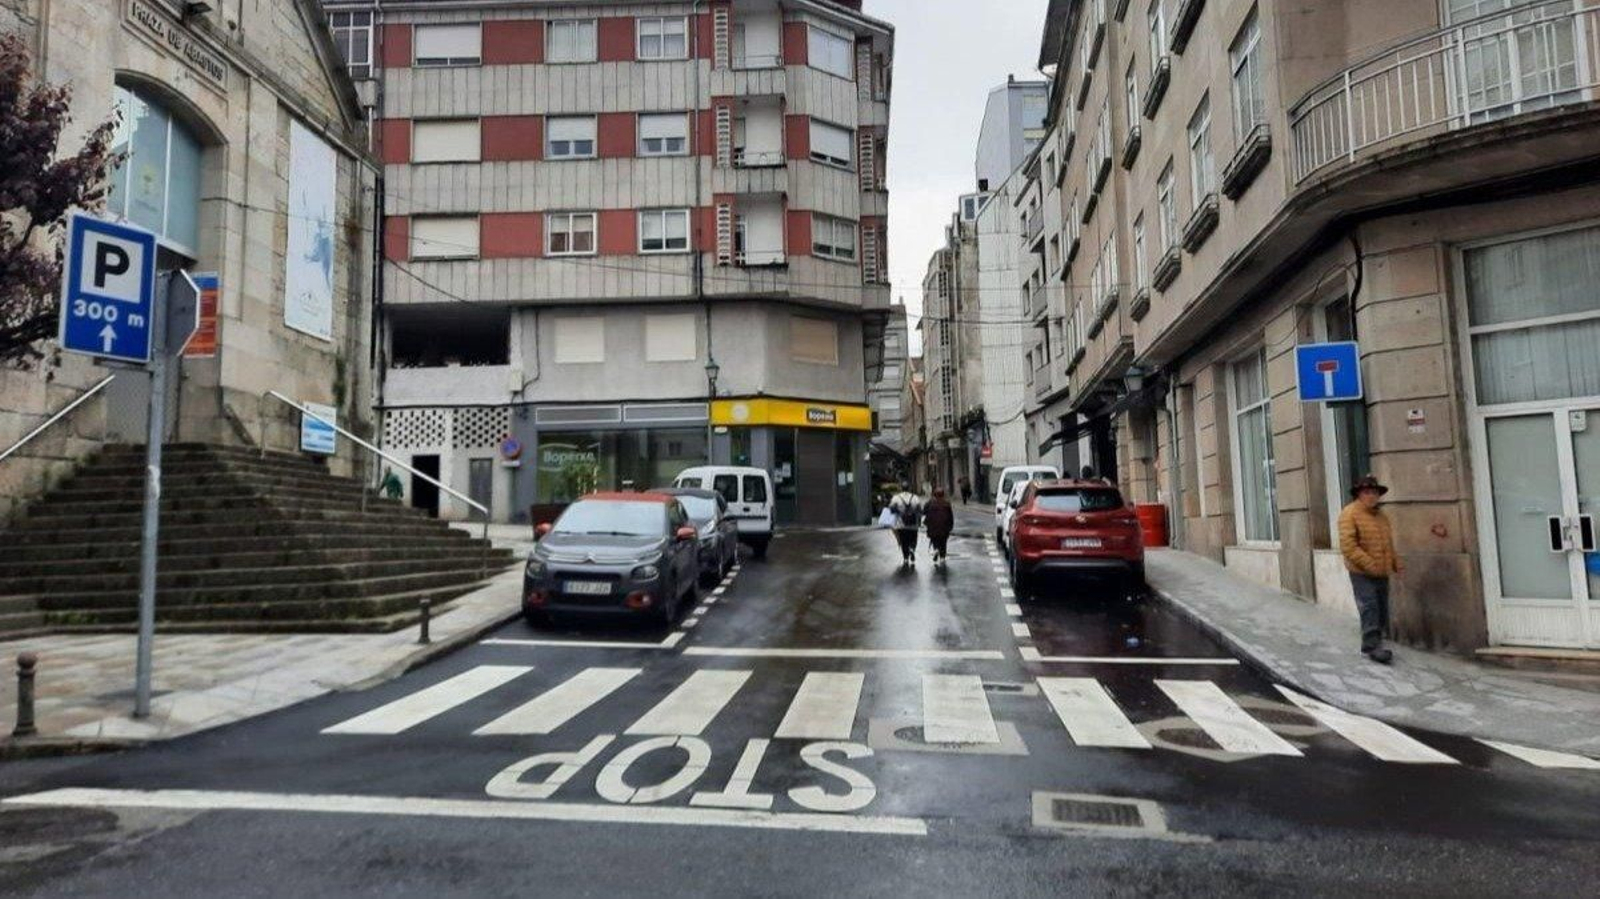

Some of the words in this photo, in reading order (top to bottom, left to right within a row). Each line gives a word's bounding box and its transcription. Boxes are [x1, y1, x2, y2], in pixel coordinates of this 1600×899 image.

[167, 29, 181, 50] DE
[184, 43, 223, 81] ABASTOS
[94, 241, 130, 289] P
[73, 299, 118, 323] 300
[127, 313, 144, 328] m
[485, 733, 877, 812] STOP
